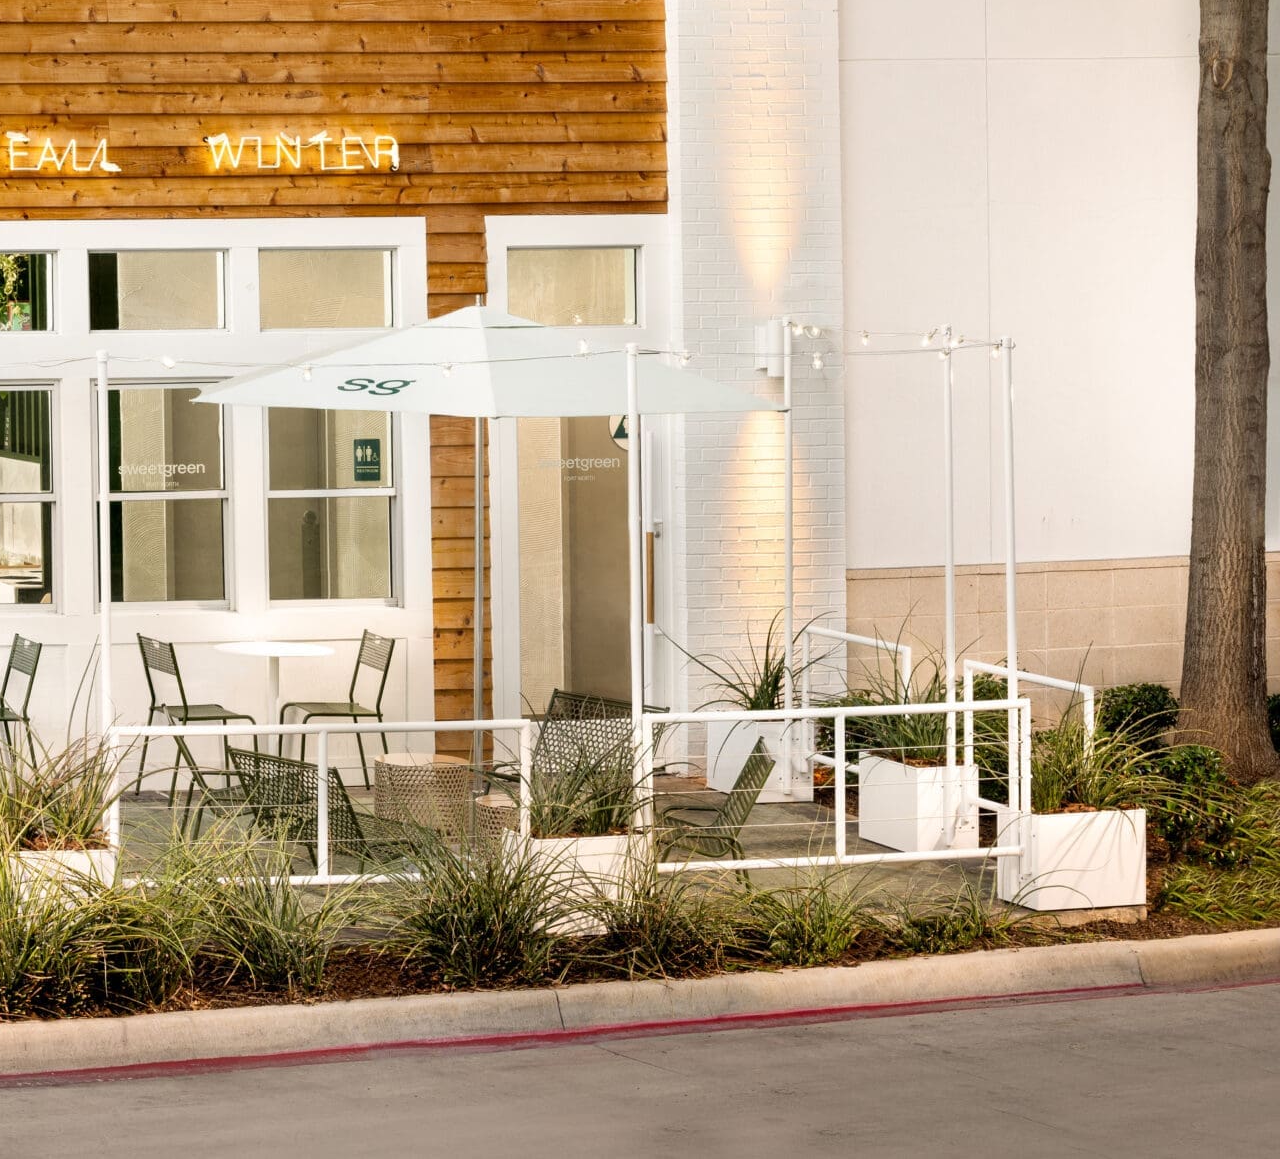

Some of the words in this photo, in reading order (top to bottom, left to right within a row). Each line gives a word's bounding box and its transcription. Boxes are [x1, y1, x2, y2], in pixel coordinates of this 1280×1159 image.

[8, 134, 122, 172] FALL
[208, 133, 400, 172] WINTER
[336, 377, 417, 396] sg
[118, 463, 206, 477] sweetgreen
